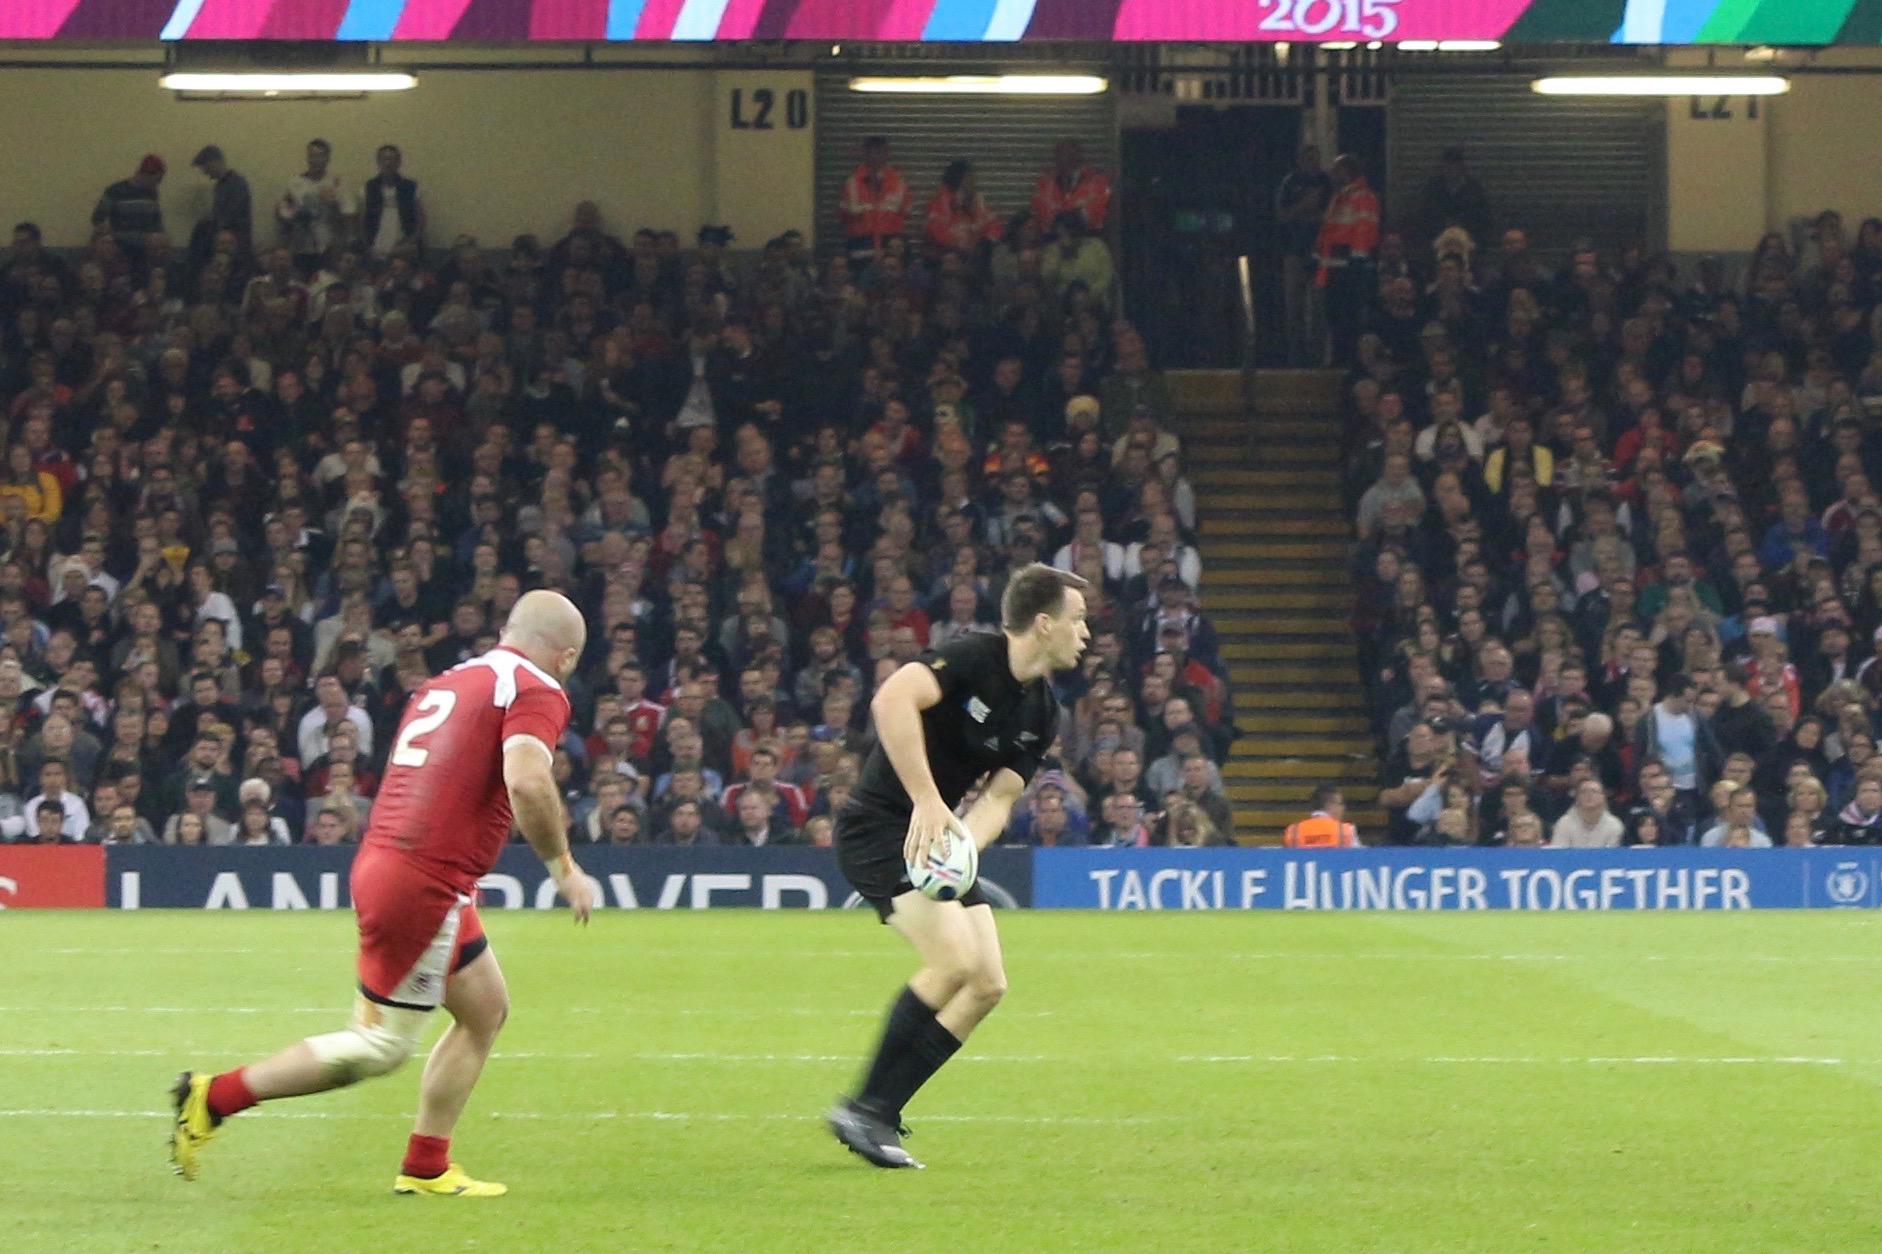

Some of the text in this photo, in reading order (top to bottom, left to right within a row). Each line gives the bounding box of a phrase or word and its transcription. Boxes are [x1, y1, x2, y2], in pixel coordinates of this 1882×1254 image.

[1258, 0, 1399, 38] 2015
[391, 689, 455, 767] 2
[1089, 861, 1751, 909] TACKLE HUNGER TOGETHER
